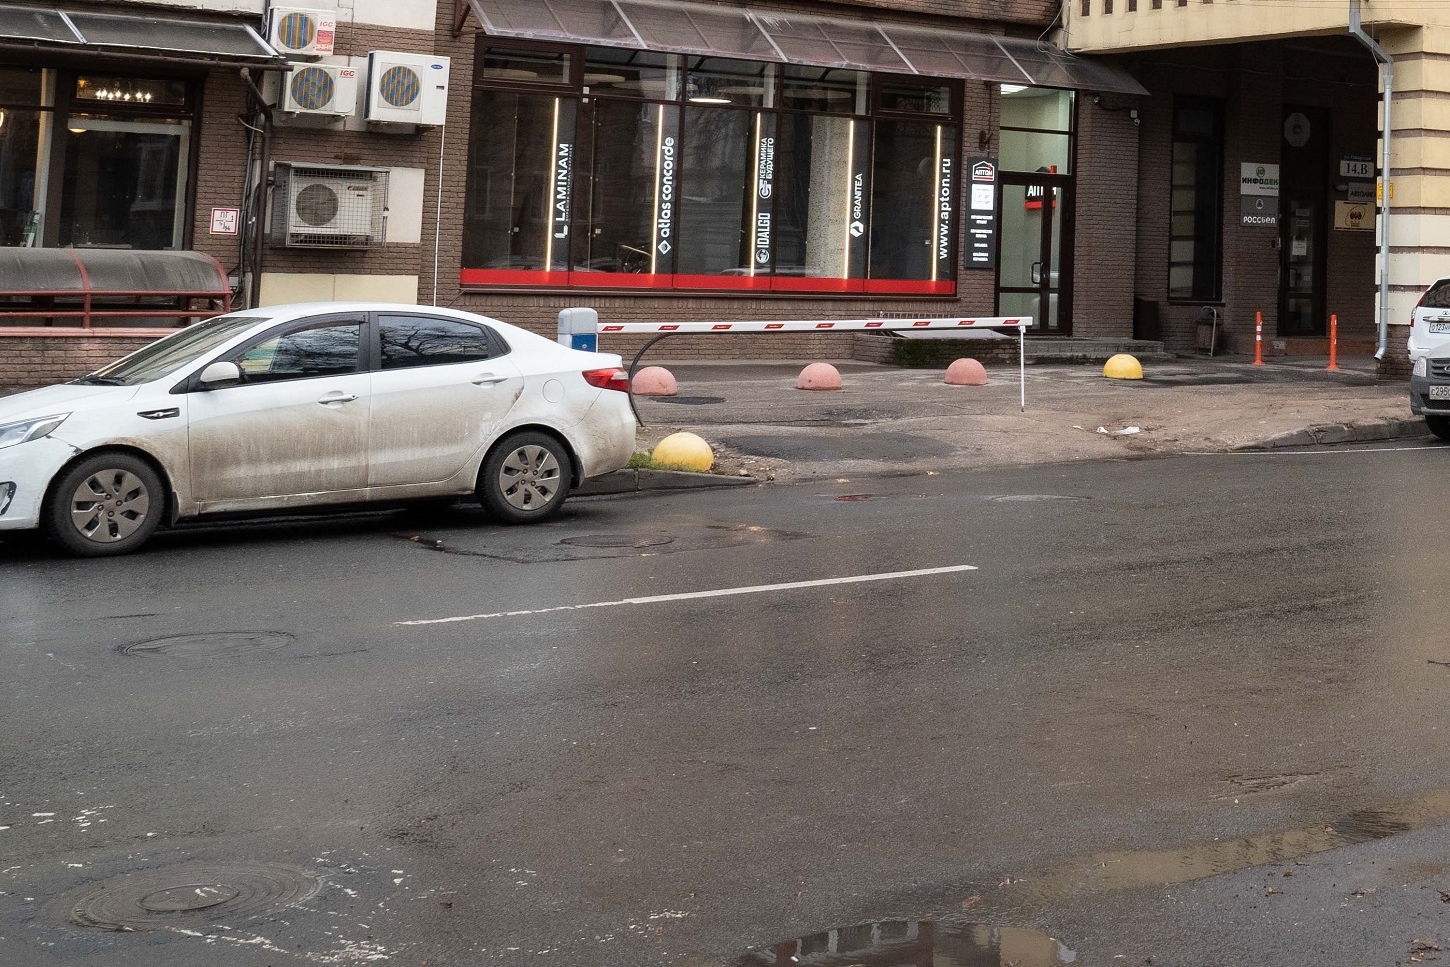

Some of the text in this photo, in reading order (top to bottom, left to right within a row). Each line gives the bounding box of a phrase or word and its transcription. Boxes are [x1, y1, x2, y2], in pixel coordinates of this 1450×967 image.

[340, 69, 355, 77] IGC
[760, 137, 768, 178] КЕРАМИКА
[766, 138, 774, 179] БУДУЩЕГО
[555, 143, 569, 221] LAMINAM
[658, 137, 674, 237] atlas concorde
[853, 173, 863, 219] GRANITEA
[940, 158, 952, 259] www.apton.ru
[757, 213, 770, 248] IDALGO
